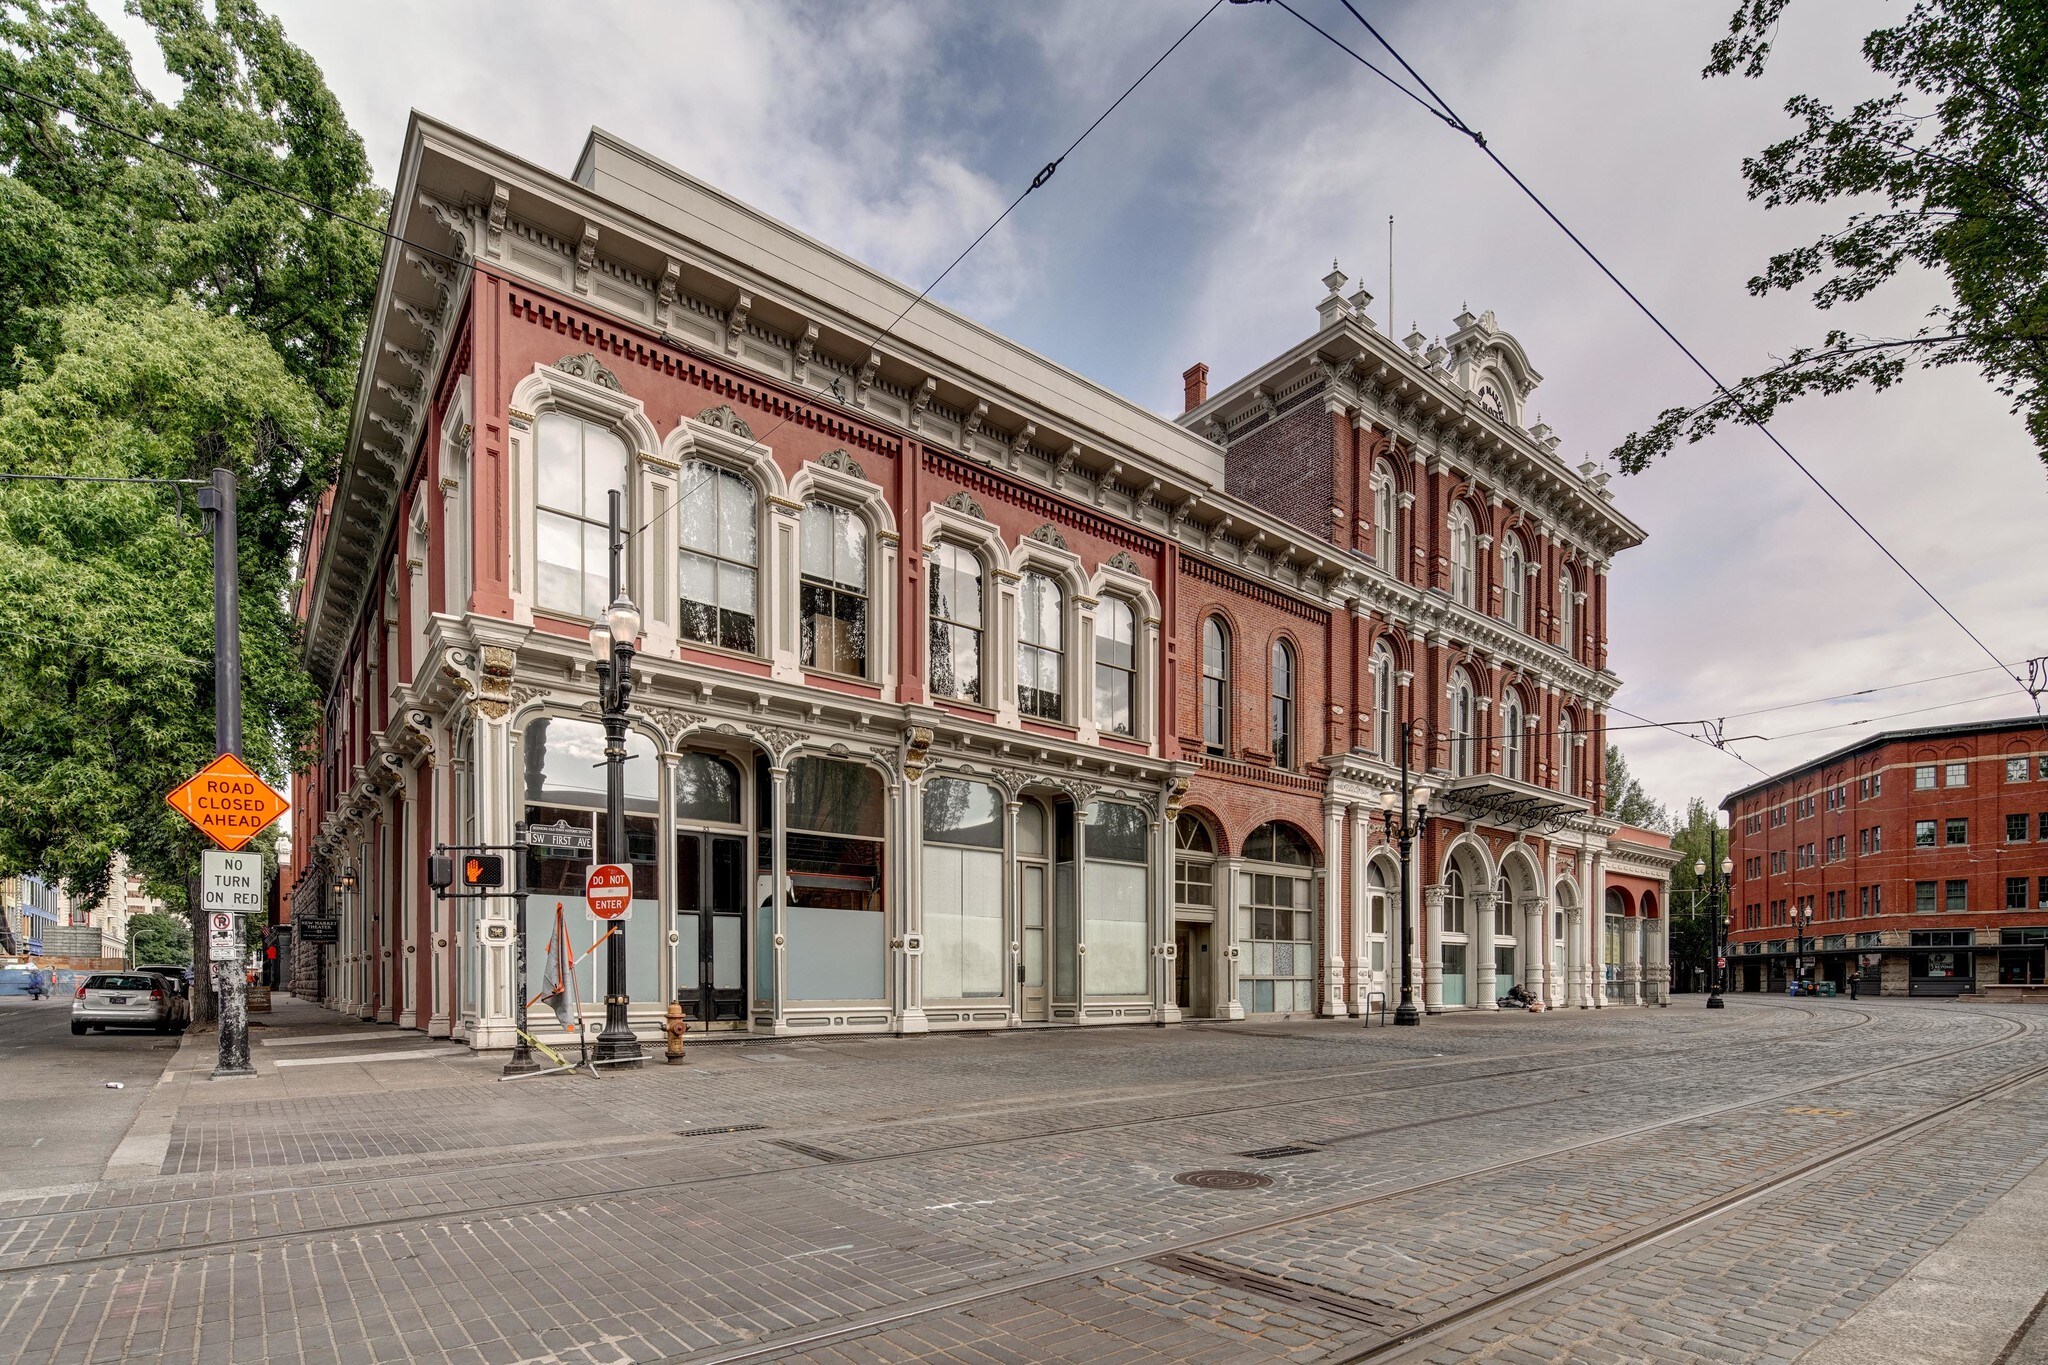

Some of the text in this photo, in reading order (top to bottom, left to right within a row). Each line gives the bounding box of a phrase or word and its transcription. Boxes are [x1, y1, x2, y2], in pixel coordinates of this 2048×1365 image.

[207, 780, 254, 795] ROAD
[198, 797, 265, 811] CLOSED
[202, 814, 261, 827] AHEAD
[532, 834, 591, 847] SW FIRST AVE
[225, 859, 242, 870] NO
[215, 875, 249, 887] TURN
[593, 875, 625, 885] DO NOT
[206, 891, 258, 904] ON RED
[595, 900, 622, 909] ENTER
